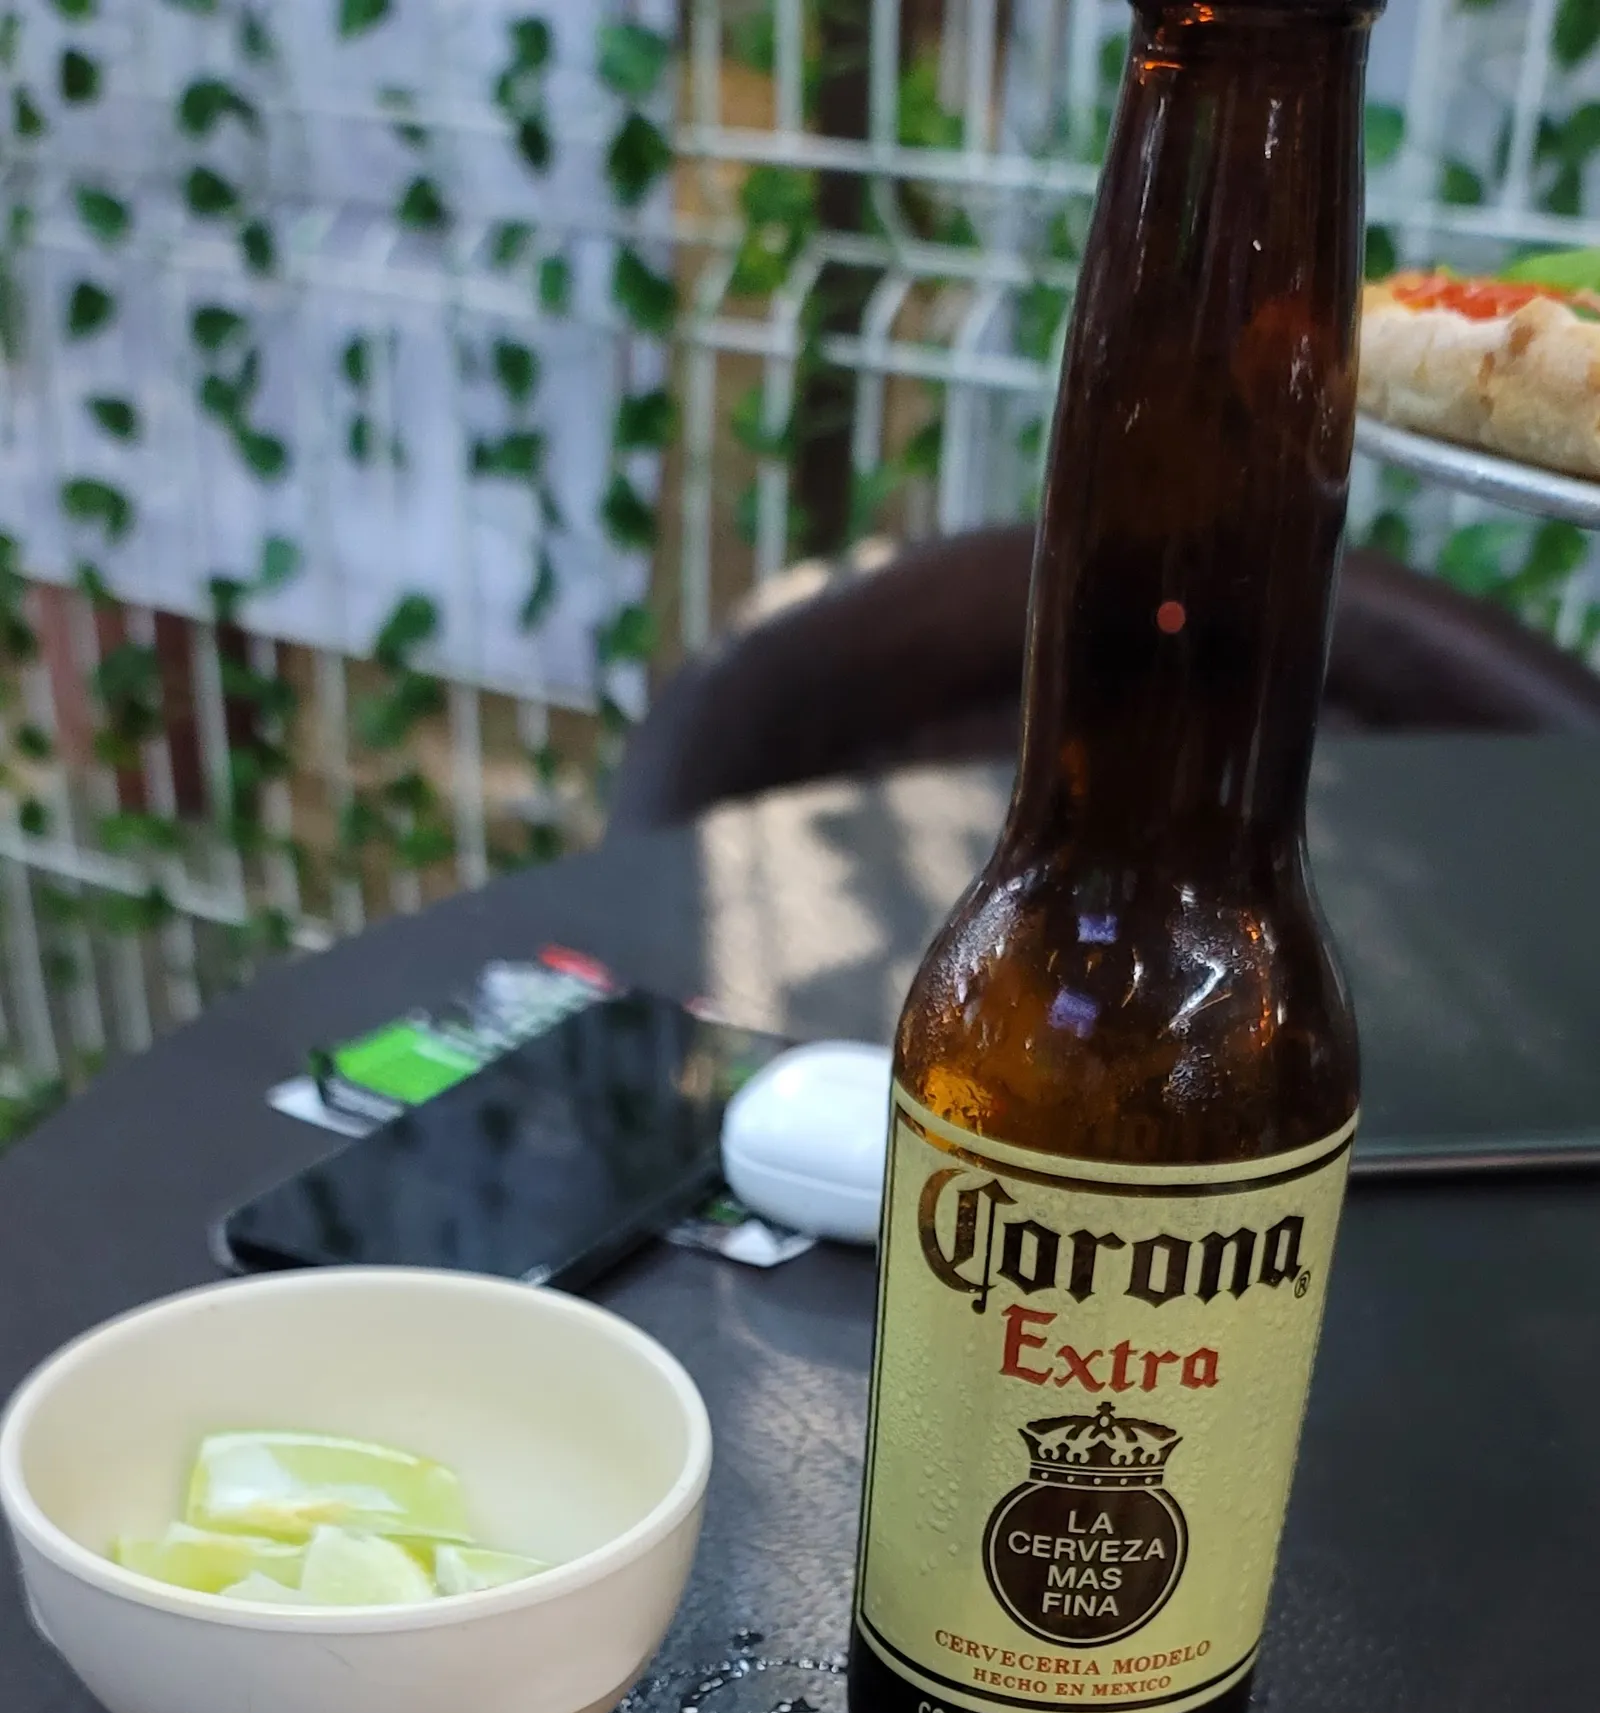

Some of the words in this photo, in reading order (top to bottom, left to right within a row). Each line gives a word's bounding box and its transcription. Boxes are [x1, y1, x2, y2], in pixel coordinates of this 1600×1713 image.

[918, 1168, 1304, 1314] Corona
[1000, 1304, 1220, 1393] Extra
[1067, 1510, 1114, 1534] LA
[1007, 1530, 1165, 1562] CERVEZA
[1047, 1564, 1123, 1590] MAS
[1041, 1591, 1120, 1617] FINA
[934, 1629, 1101, 1676] CERVECERIA
[1111, 1639, 1211, 1675] MODELO
[972, 1667, 1048, 1695] HECHO
[1054, 1682, 1085, 1697] EN
[1091, 1675, 1172, 1697] MEXICO
